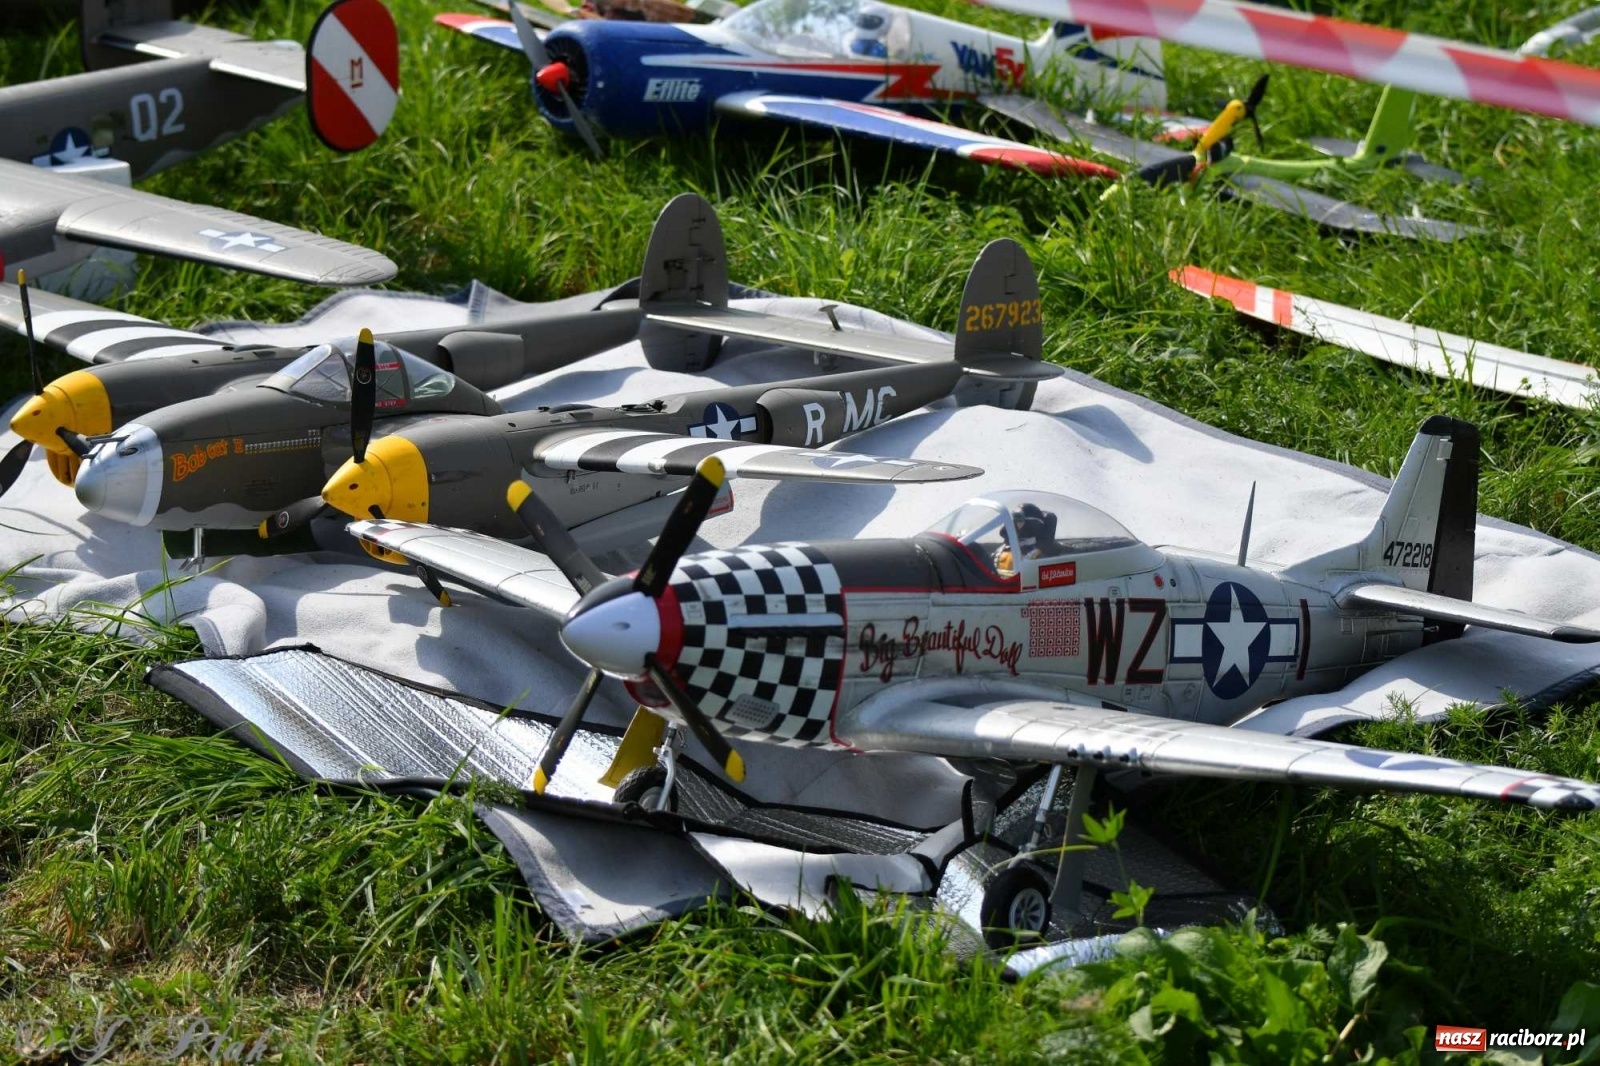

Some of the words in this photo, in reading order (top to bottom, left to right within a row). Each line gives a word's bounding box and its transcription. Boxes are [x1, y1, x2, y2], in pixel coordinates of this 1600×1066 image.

[965, 299, 1042, 331] 267923
[802, 402, 826, 446] R
[1383, 541, 1433, 568] 472218
[859, 622, 896, 684] Big
[902, 615, 982, 676] Beautiful
[983, 625, 1023, 676] Doll
[1084, 597, 1167, 686] WZ
